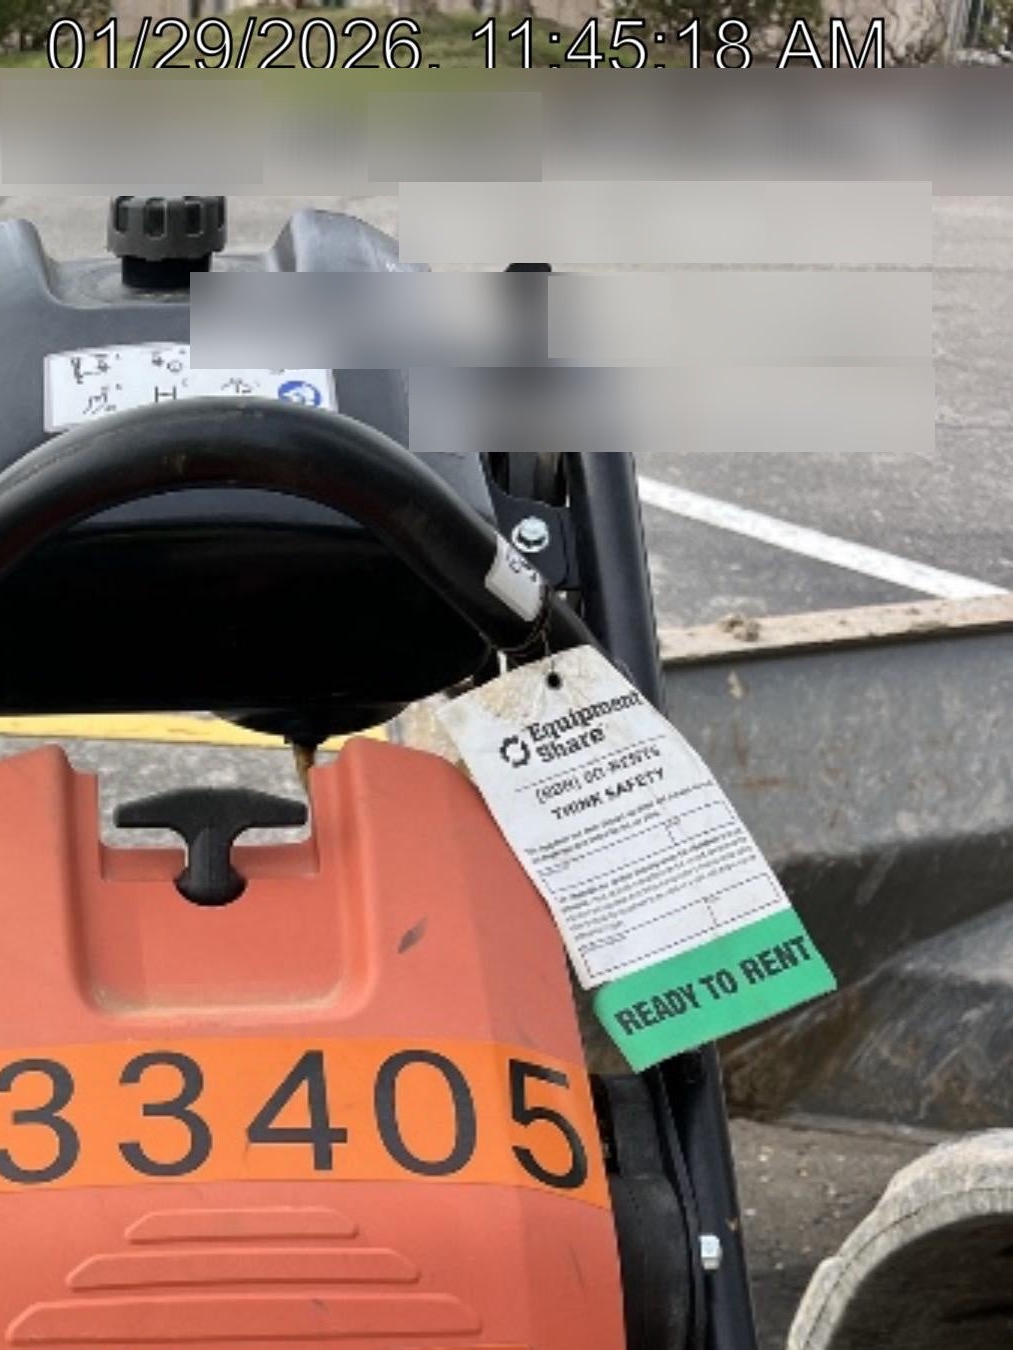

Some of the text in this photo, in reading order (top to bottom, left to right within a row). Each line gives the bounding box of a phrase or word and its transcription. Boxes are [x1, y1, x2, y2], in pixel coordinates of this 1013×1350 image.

[526, 689, 645, 742] Equipment
[536, 726, 606, 763] Share
[550, 791, 604, 820] THINK
[605, 766, 664, 798] SAFETY
[613, 935, 812, 1036] READY TO RENT
